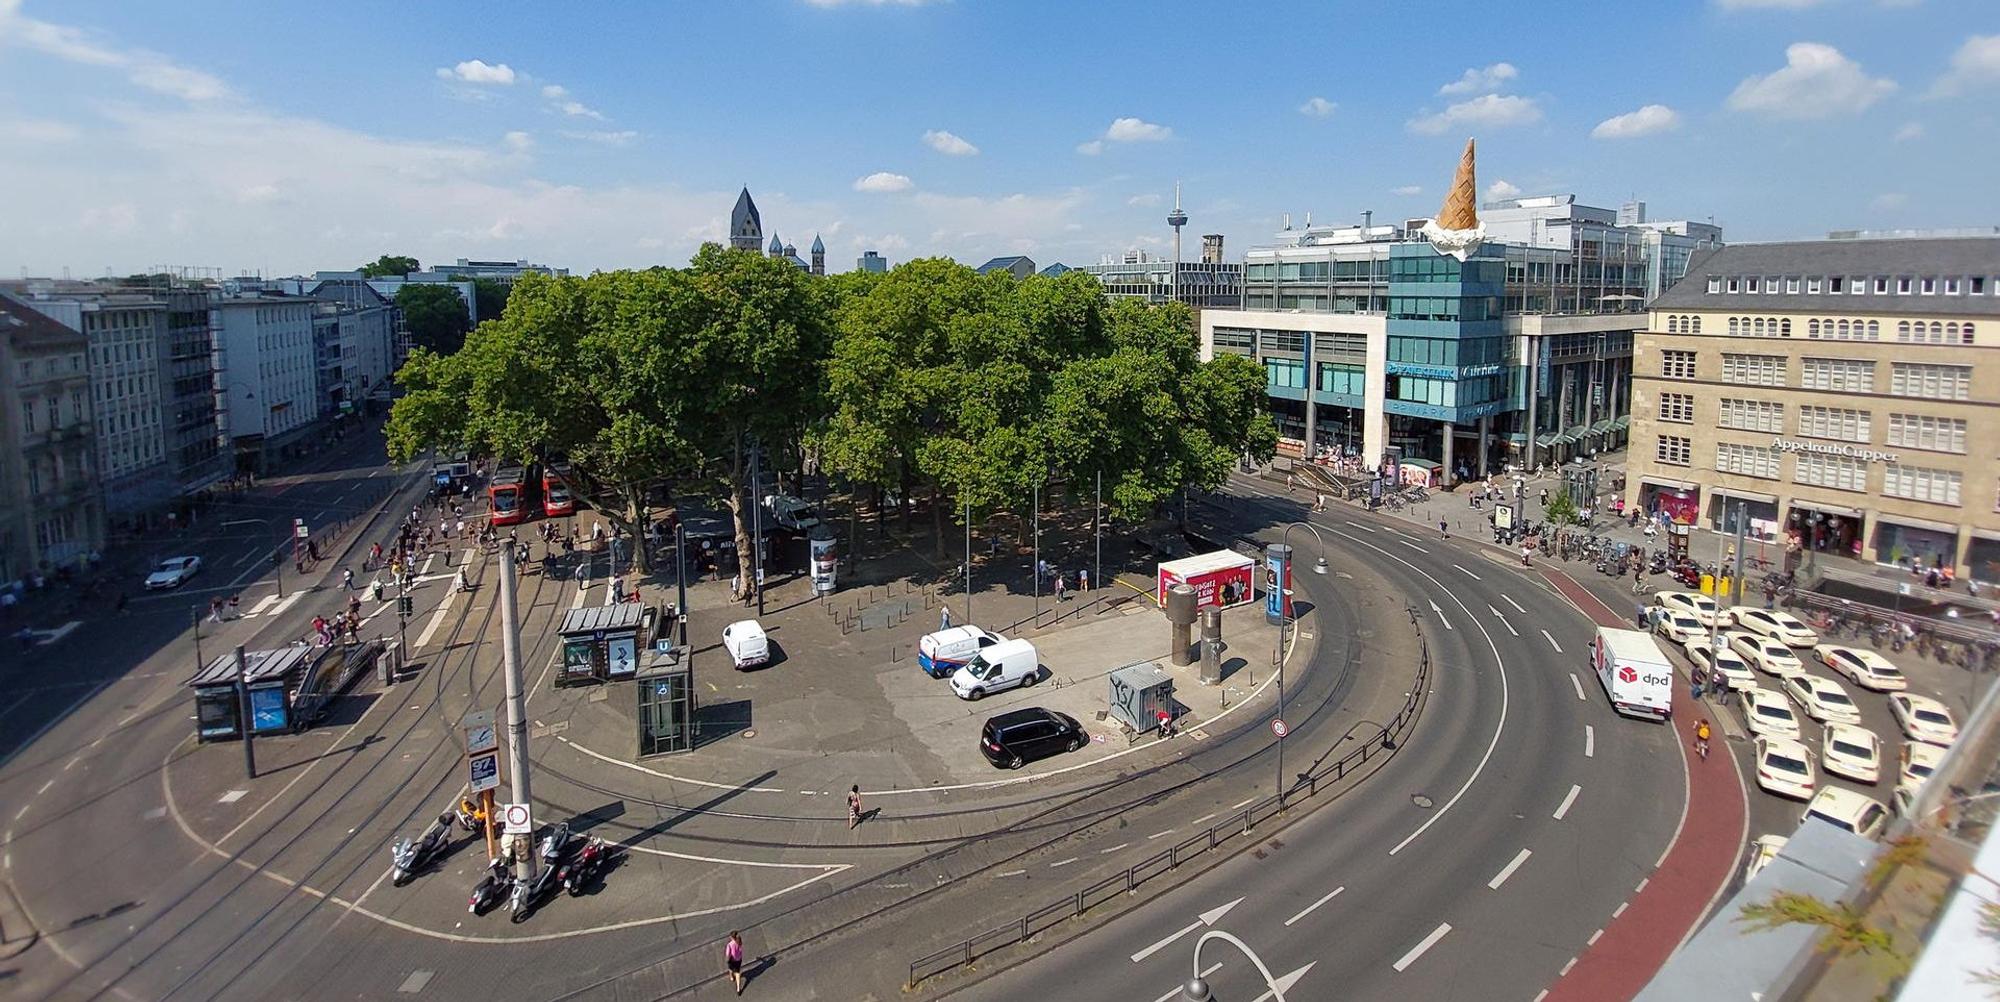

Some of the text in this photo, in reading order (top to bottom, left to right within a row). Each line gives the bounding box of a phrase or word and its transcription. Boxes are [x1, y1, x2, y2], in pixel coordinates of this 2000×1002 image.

[1770, 437, 1898, 463] AppelrathCupper
[659, 641, 668, 651] U
[1643, 673, 1669, 686] dpd
[472, 757, 491, 771] 97
